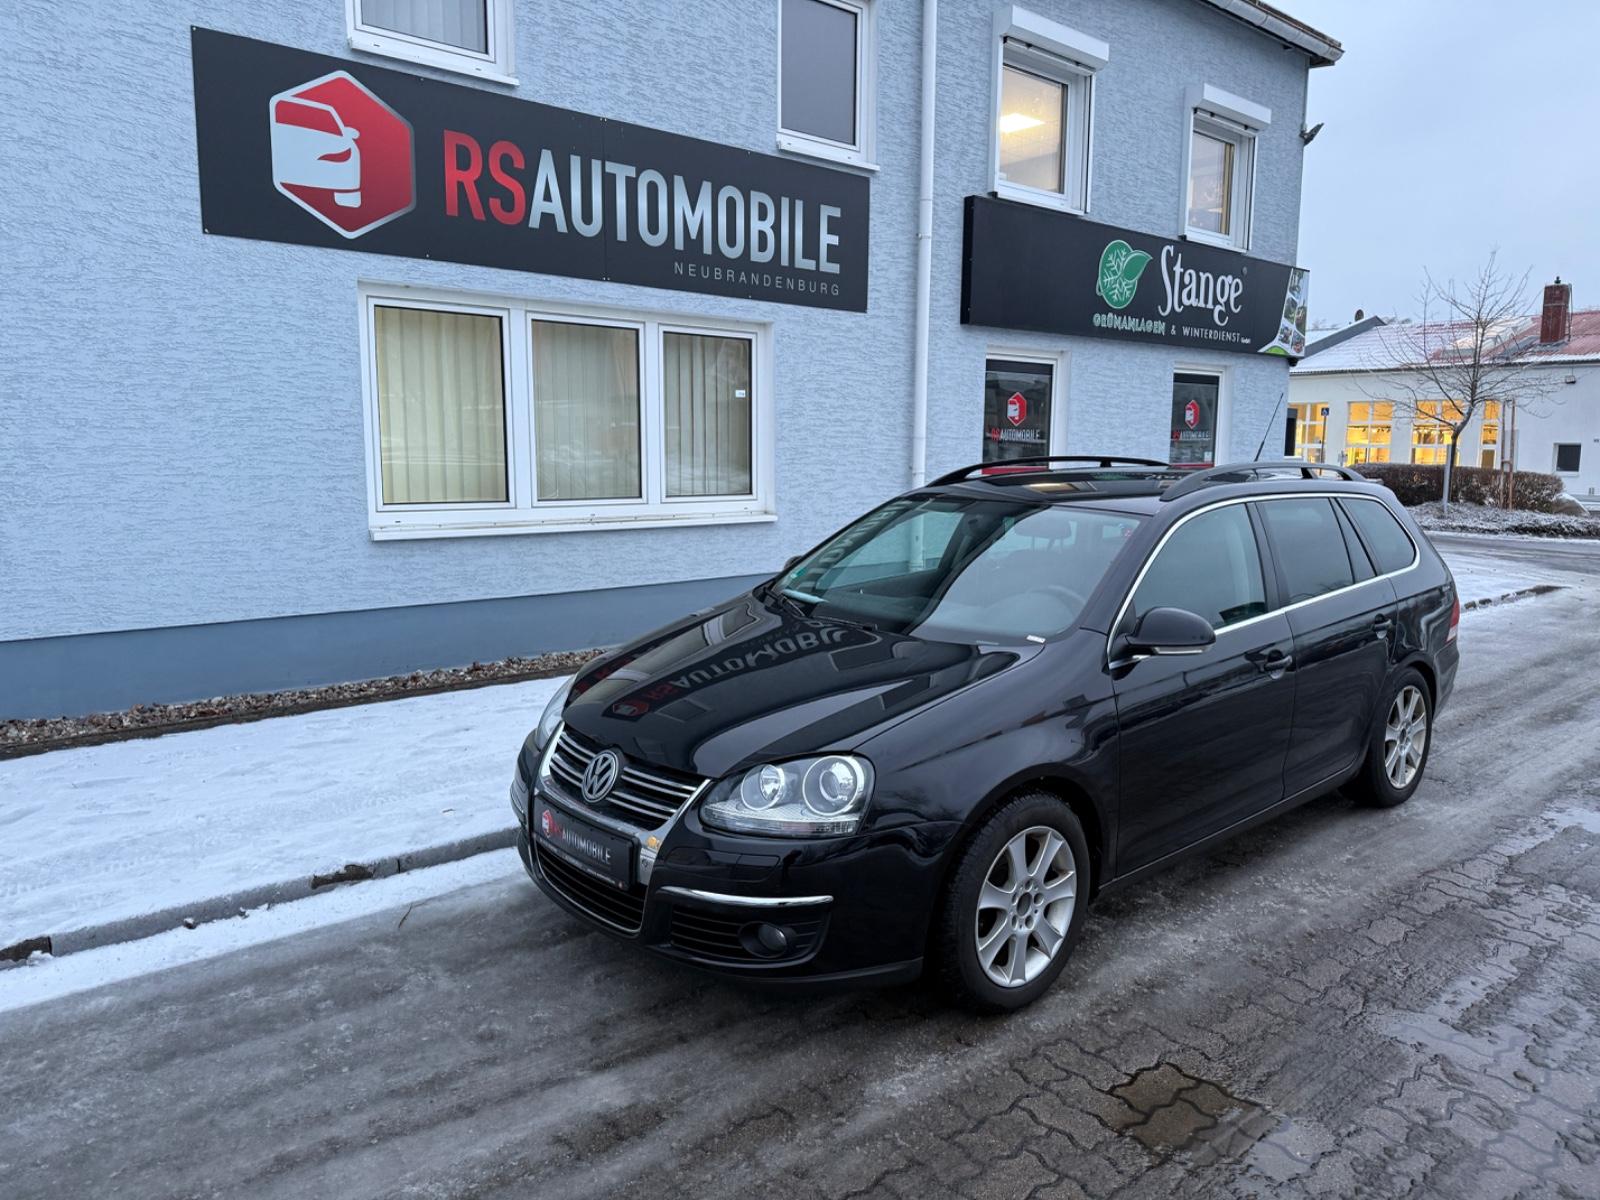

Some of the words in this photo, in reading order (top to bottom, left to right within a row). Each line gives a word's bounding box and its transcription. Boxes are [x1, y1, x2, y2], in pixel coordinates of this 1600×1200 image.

[674, 261, 840, 297] NEUBRANDENBURG
[1158, 245, 1243, 326] Stange
[1170, 324, 1177, 335] &
[1182, 325, 1241, 343] WINTERDIENST
